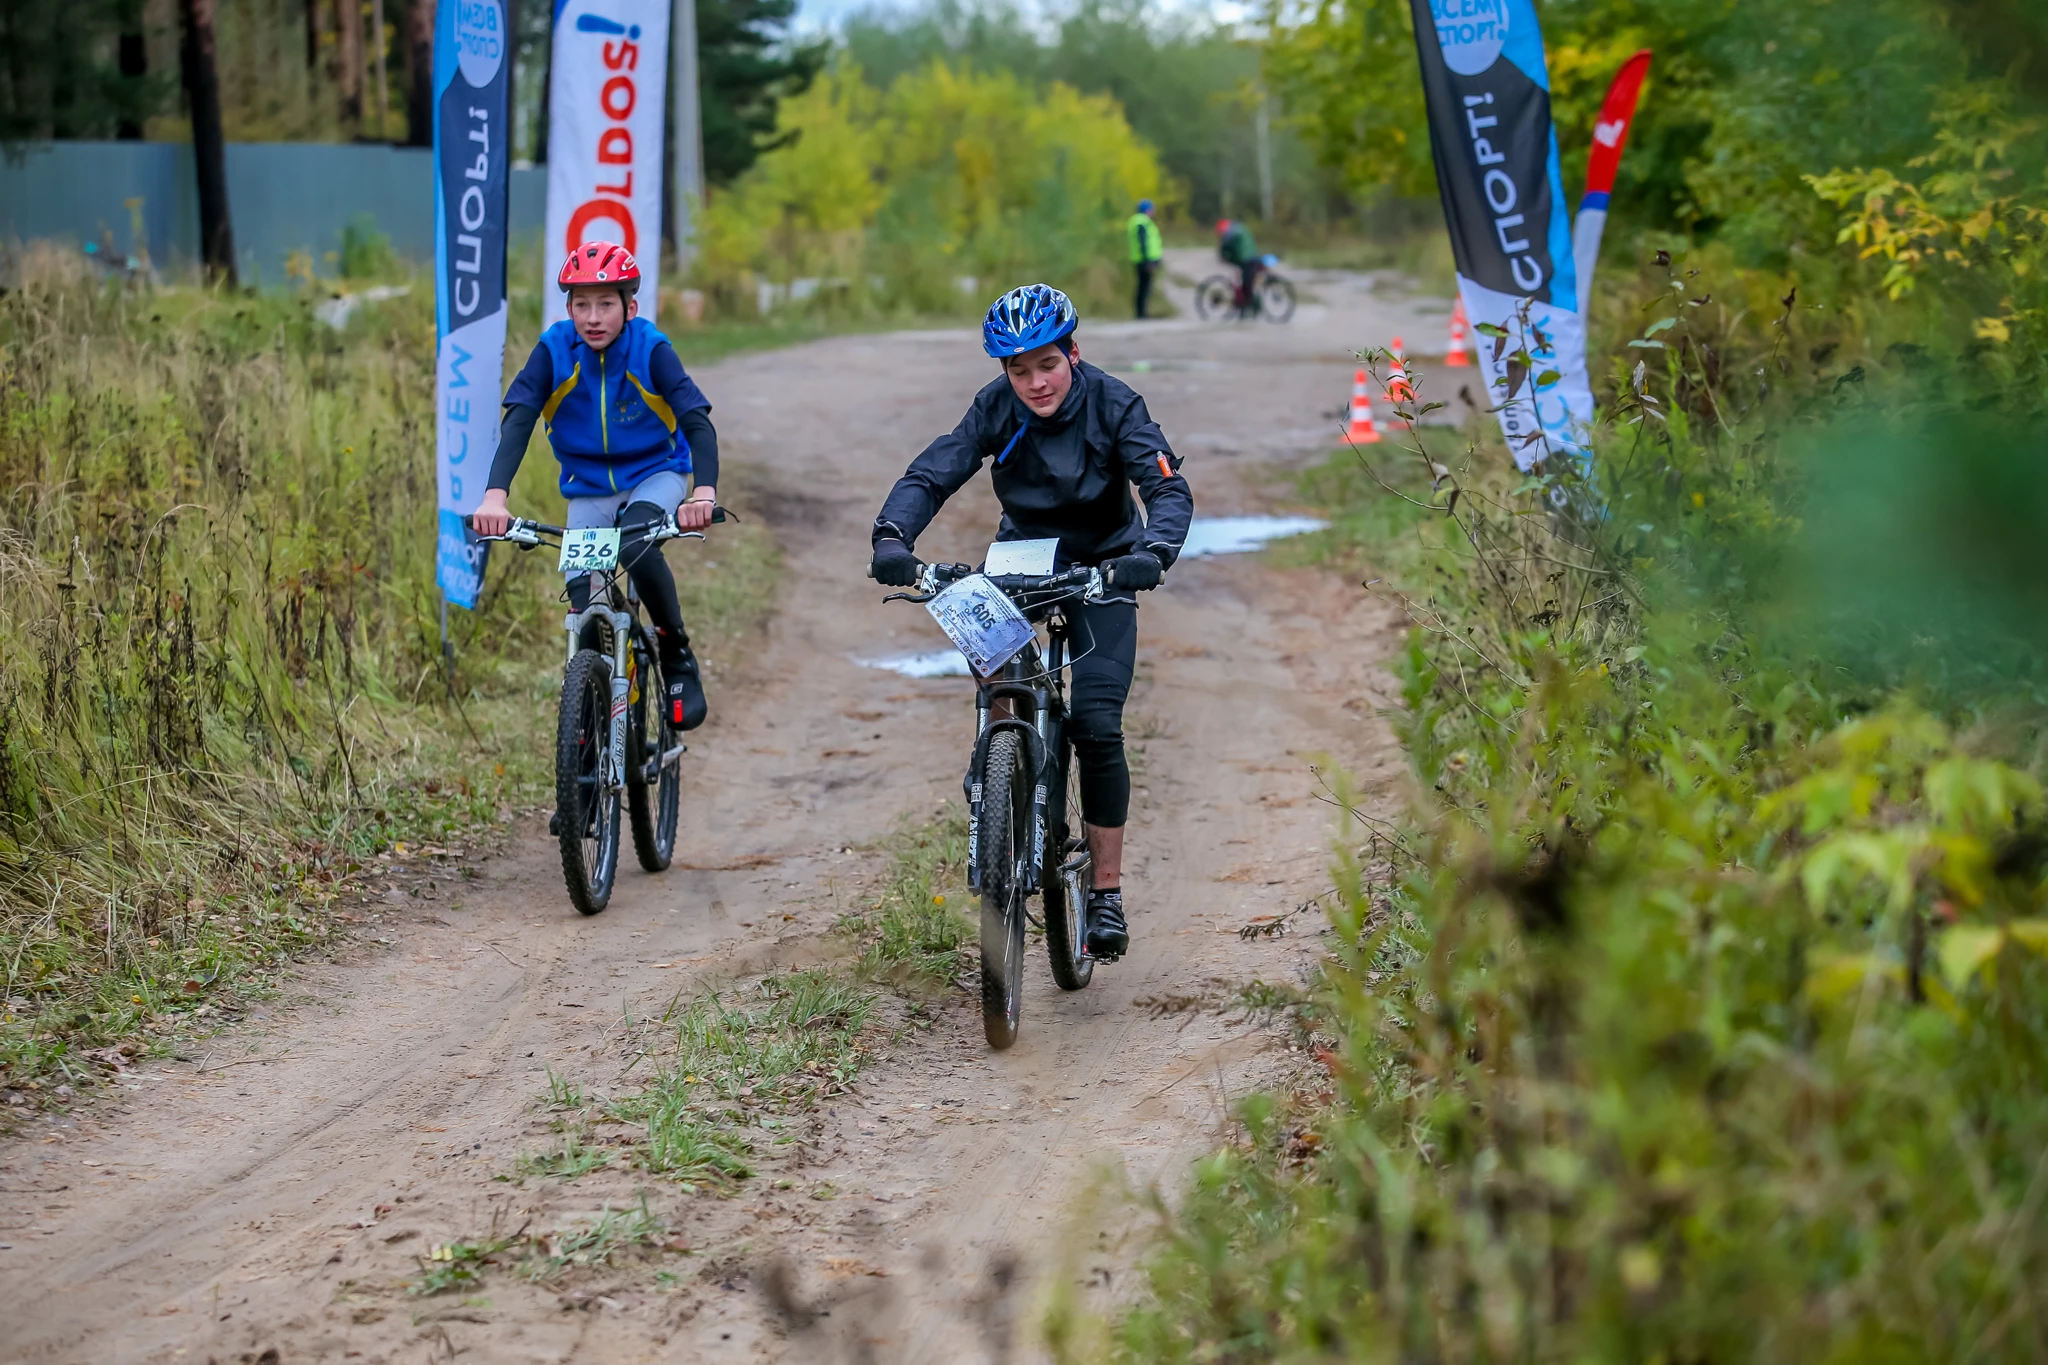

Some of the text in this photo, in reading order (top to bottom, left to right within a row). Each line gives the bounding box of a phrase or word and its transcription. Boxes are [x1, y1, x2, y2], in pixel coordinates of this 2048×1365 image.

[1463, 92, 1543, 291] СПОРТ!
[567, 543, 613, 558] 526
[972, 603, 997, 631] 605
